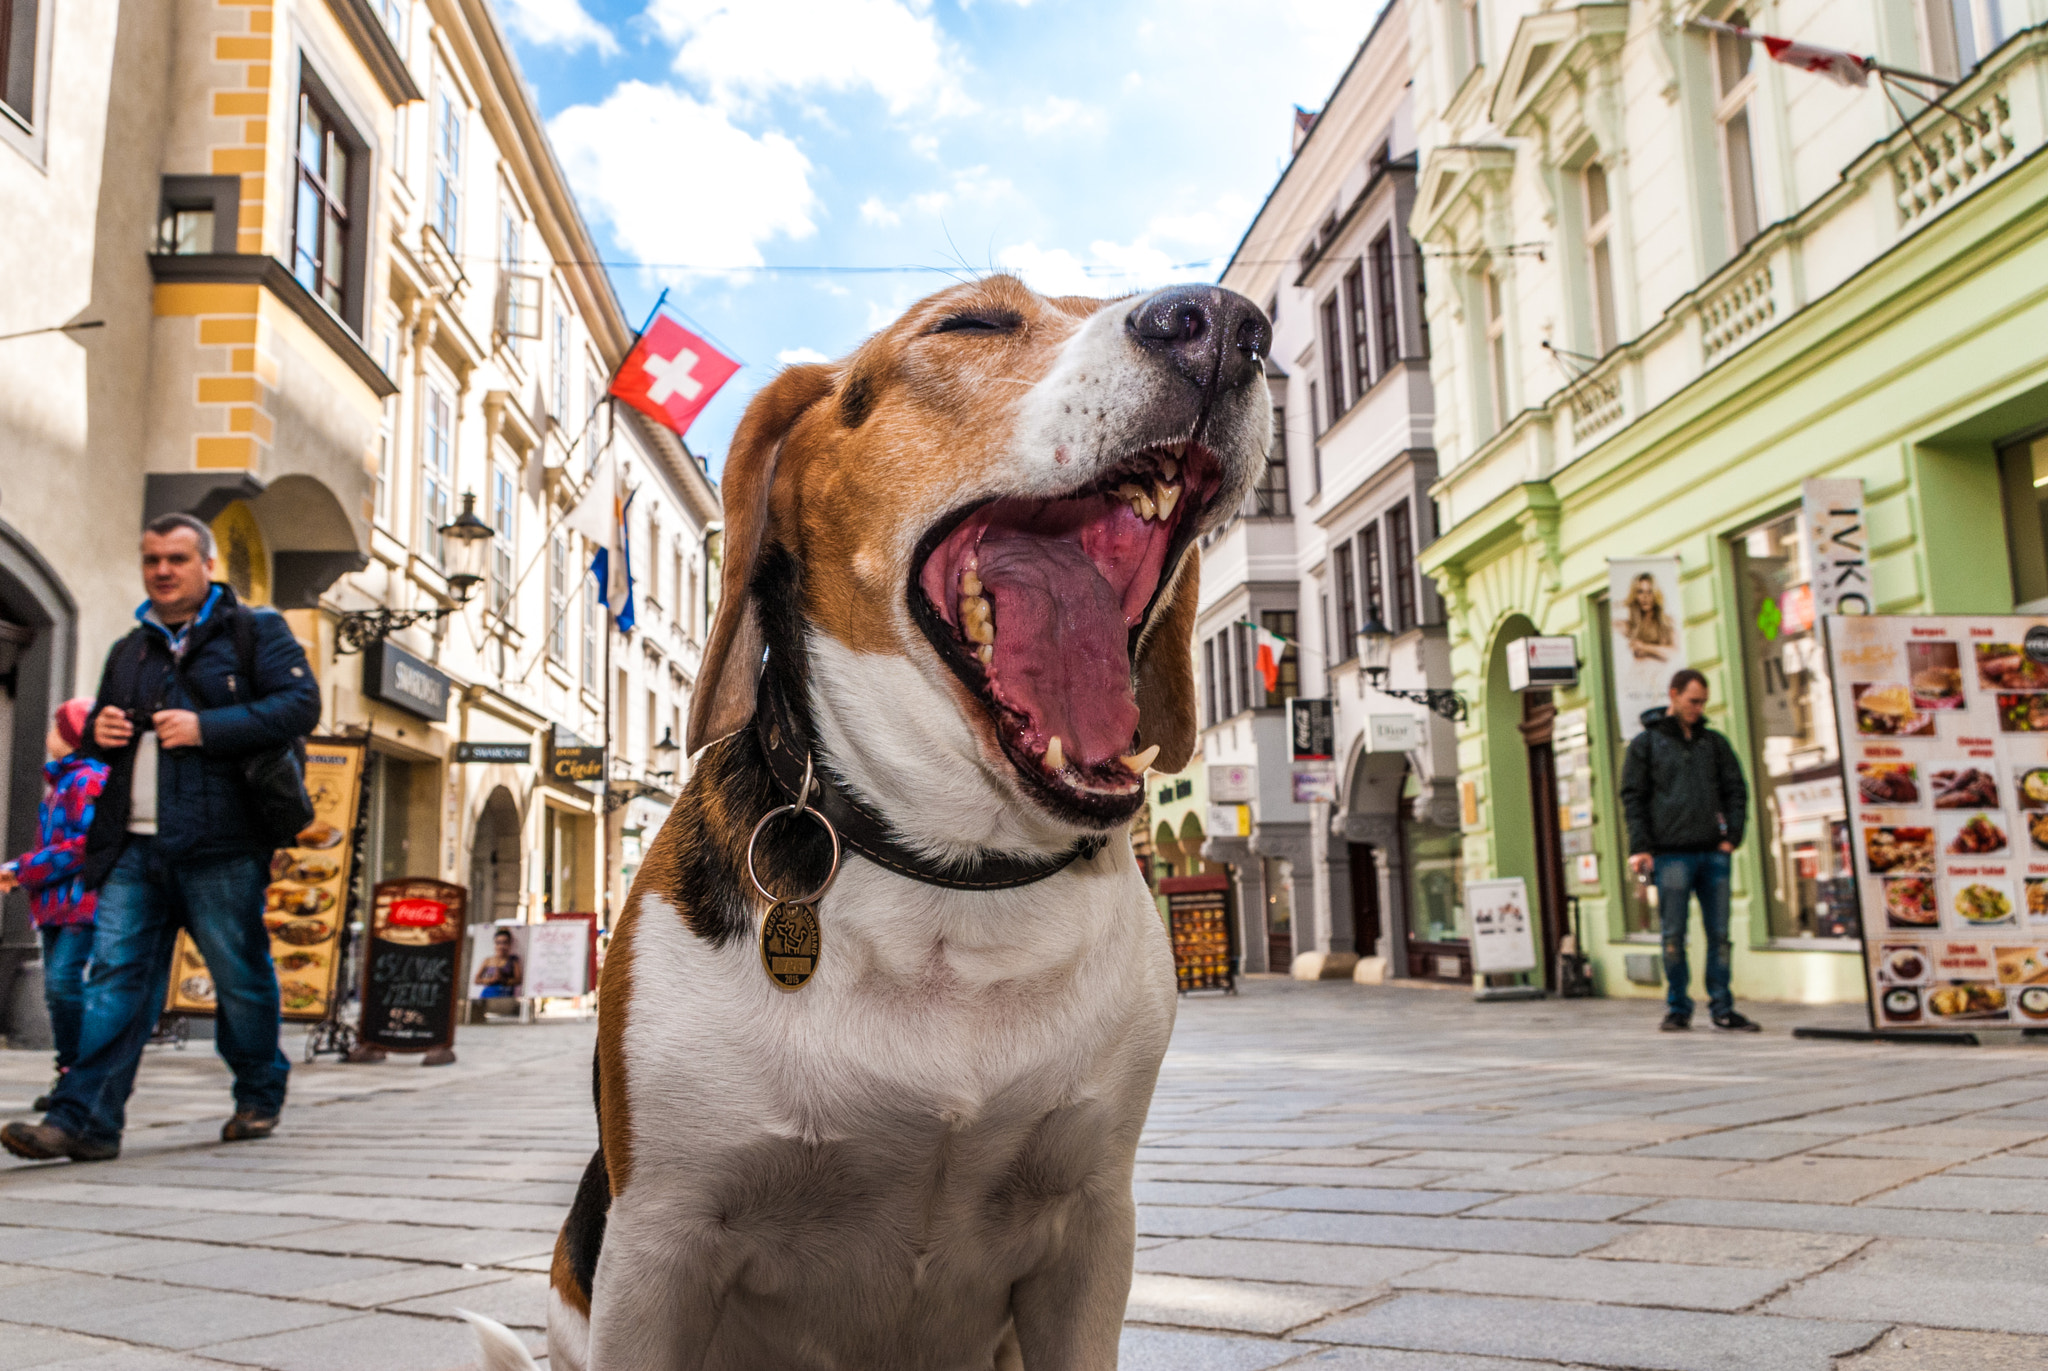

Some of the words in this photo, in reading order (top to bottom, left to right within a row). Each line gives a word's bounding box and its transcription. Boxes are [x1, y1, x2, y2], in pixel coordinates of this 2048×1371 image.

[472, 746, 527, 758] SWAROVSKI
[395, 905, 438, 922] Coca-Cola
[765, 907, 783, 937] MESTO
[784, 974, 800, 984] 2015
